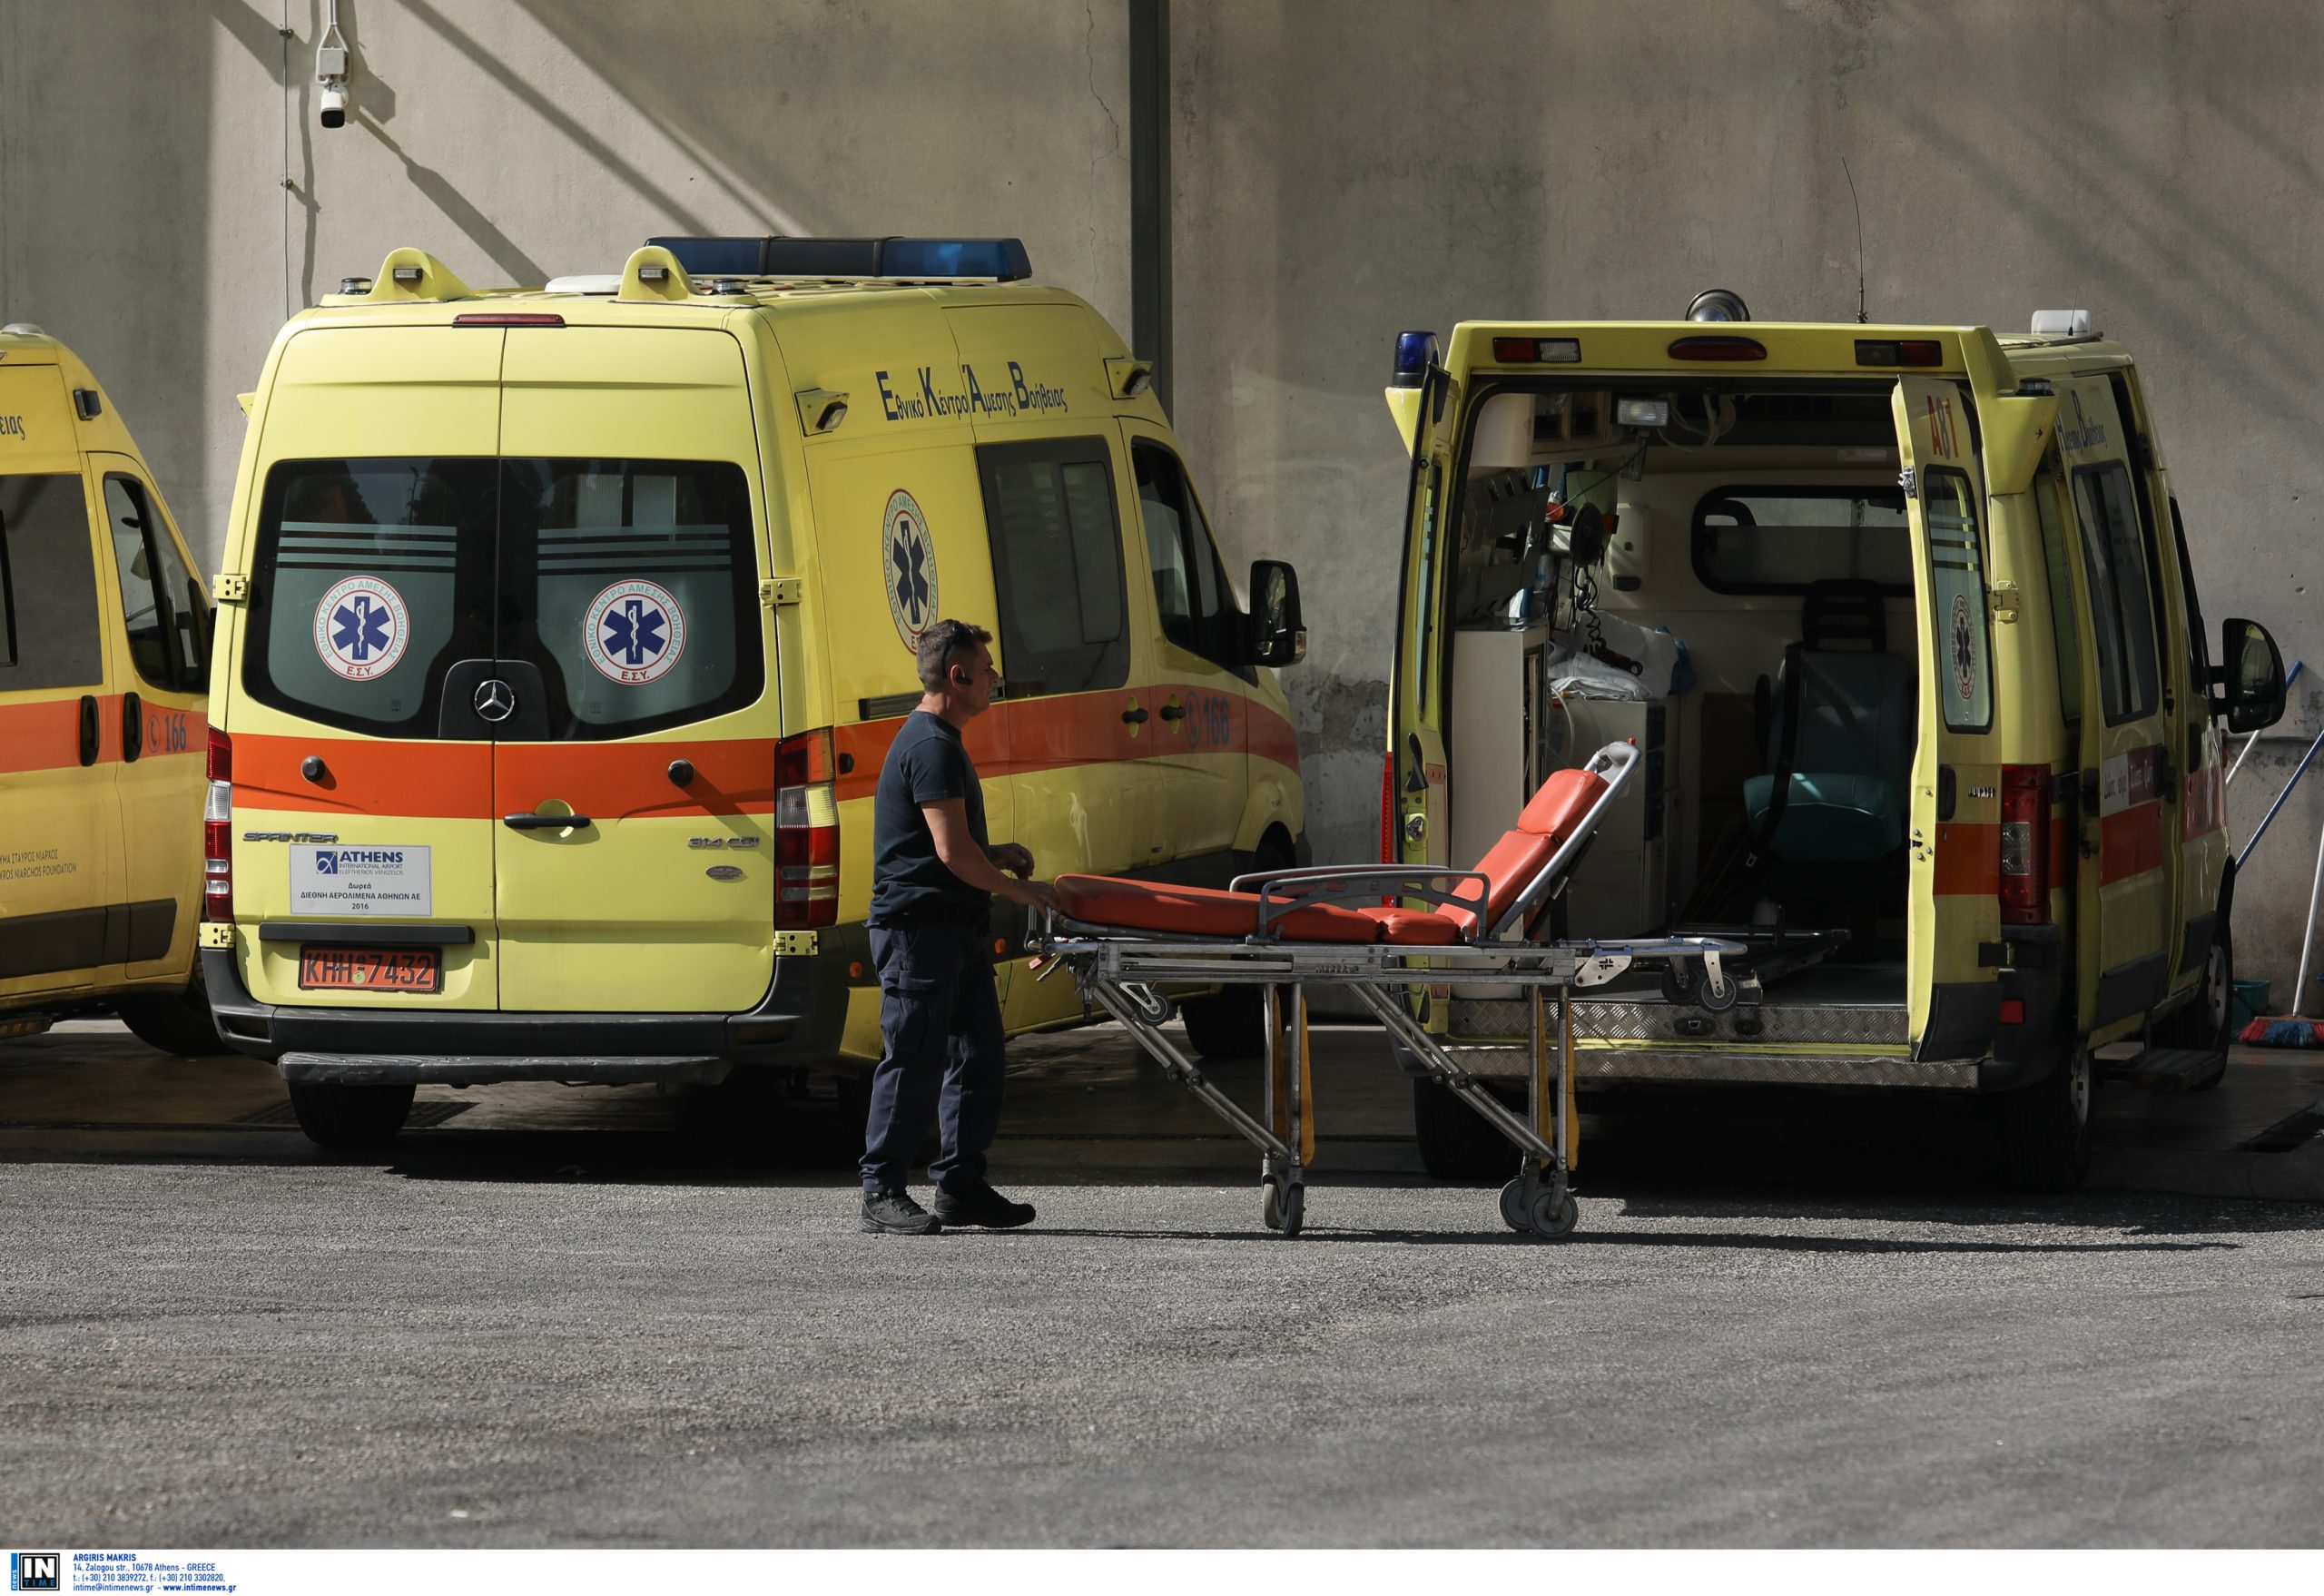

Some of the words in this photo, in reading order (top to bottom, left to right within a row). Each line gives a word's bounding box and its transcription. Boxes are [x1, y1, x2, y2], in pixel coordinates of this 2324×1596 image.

[875, 370, 923, 421] Εθνικό
[918, 366, 968, 420] Κέντρο
[1007, 361, 1068, 415] Βοήθειας
[321, 582, 356, 615] ΚΕΝΤΡΟ
[358, 581, 396, 604] ΑΜΕΣΗΣ
[590, 586, 625, 620] ΚΕΝΤΡΟ
[627, 584, 671, 606] ΑΜΕΣΗΣ
[318, 617, 333, 659] ΕΘΝΙΚΟ
[389, 605, 406, 661] ΒΟΗΘΕΙΑΣ
[587, 623, 606, 665] ΕΘΝΙΚΟ
[664, 606, 682, 664] ΒΟΗΘΕΙΑΣ
[165, 713, 187, 752] 166
[340, 851, 404, 862] ATHENS
[329, 892, 376, 900] ΑΕΡΟΛΙΜΕΝΑ
[377, 892, 409, 901] ΑΘΗΝΩΝ
[348, 882, 372, 891] Δωρεά
